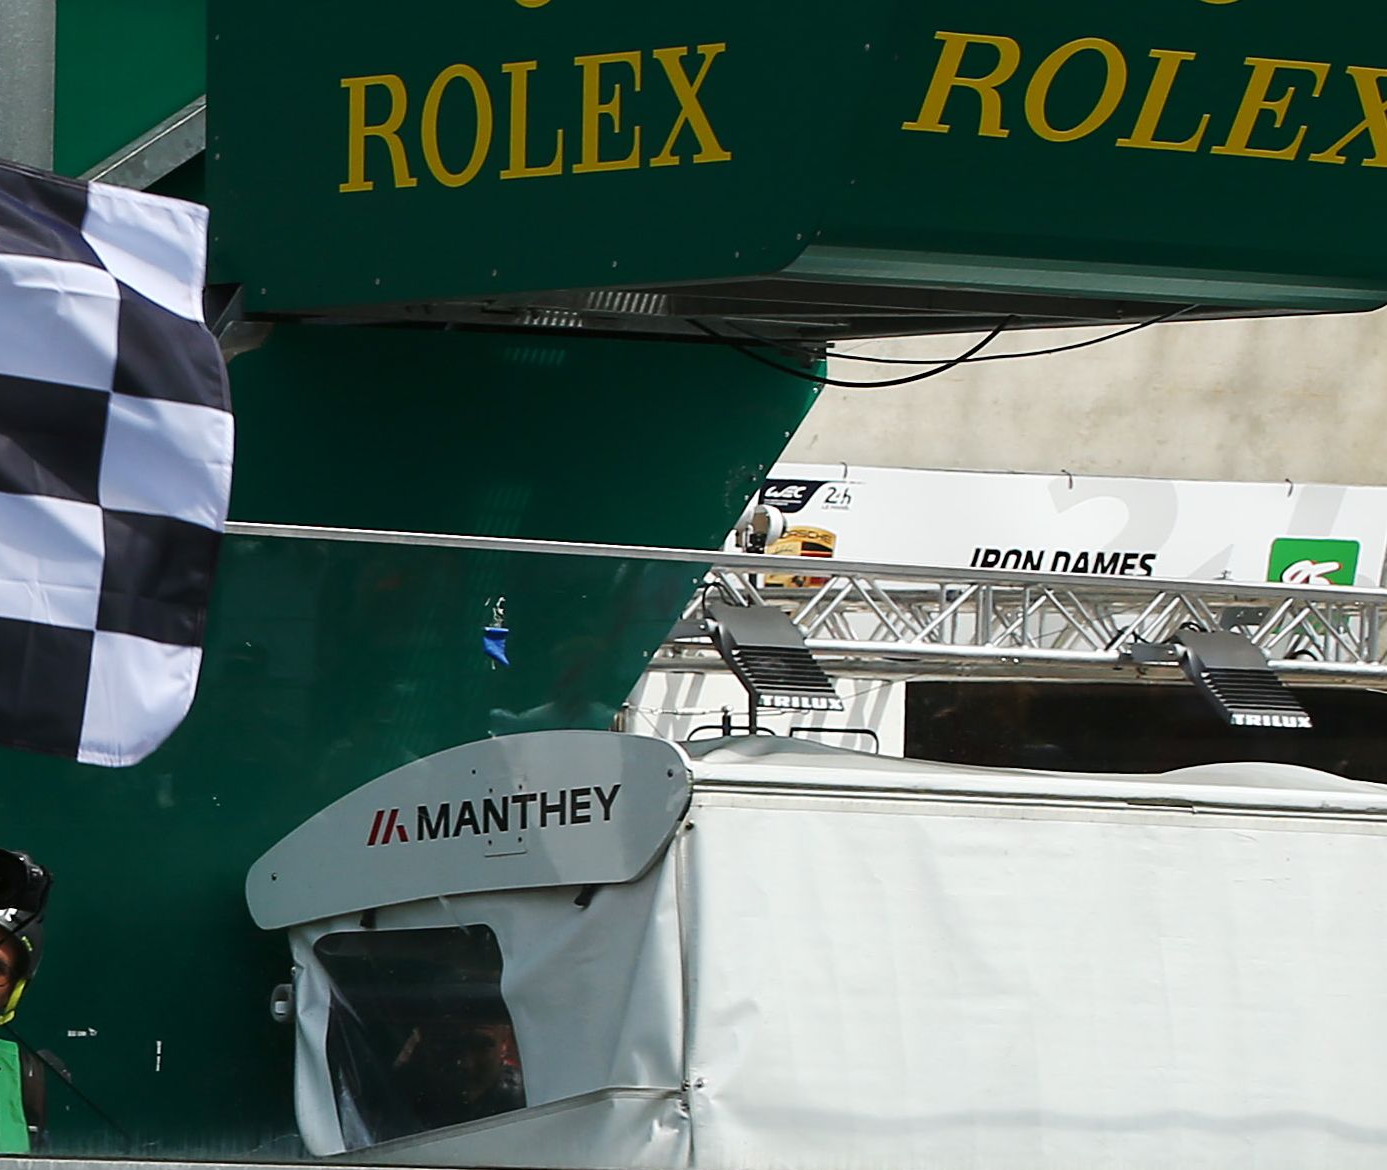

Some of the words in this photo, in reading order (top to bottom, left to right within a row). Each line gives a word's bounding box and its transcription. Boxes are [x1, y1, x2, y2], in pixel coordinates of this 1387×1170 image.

[338, 43, 733, 192] ROLEX
[971, 548, 1045, 571] IRON
[1050, 551, 1157, 578] DAMES
[760, 695, 843, 712] TRILUX
[1230, 714, 1313, 729] TRILUX
[417, 784, 622, 841] MANTHEY
